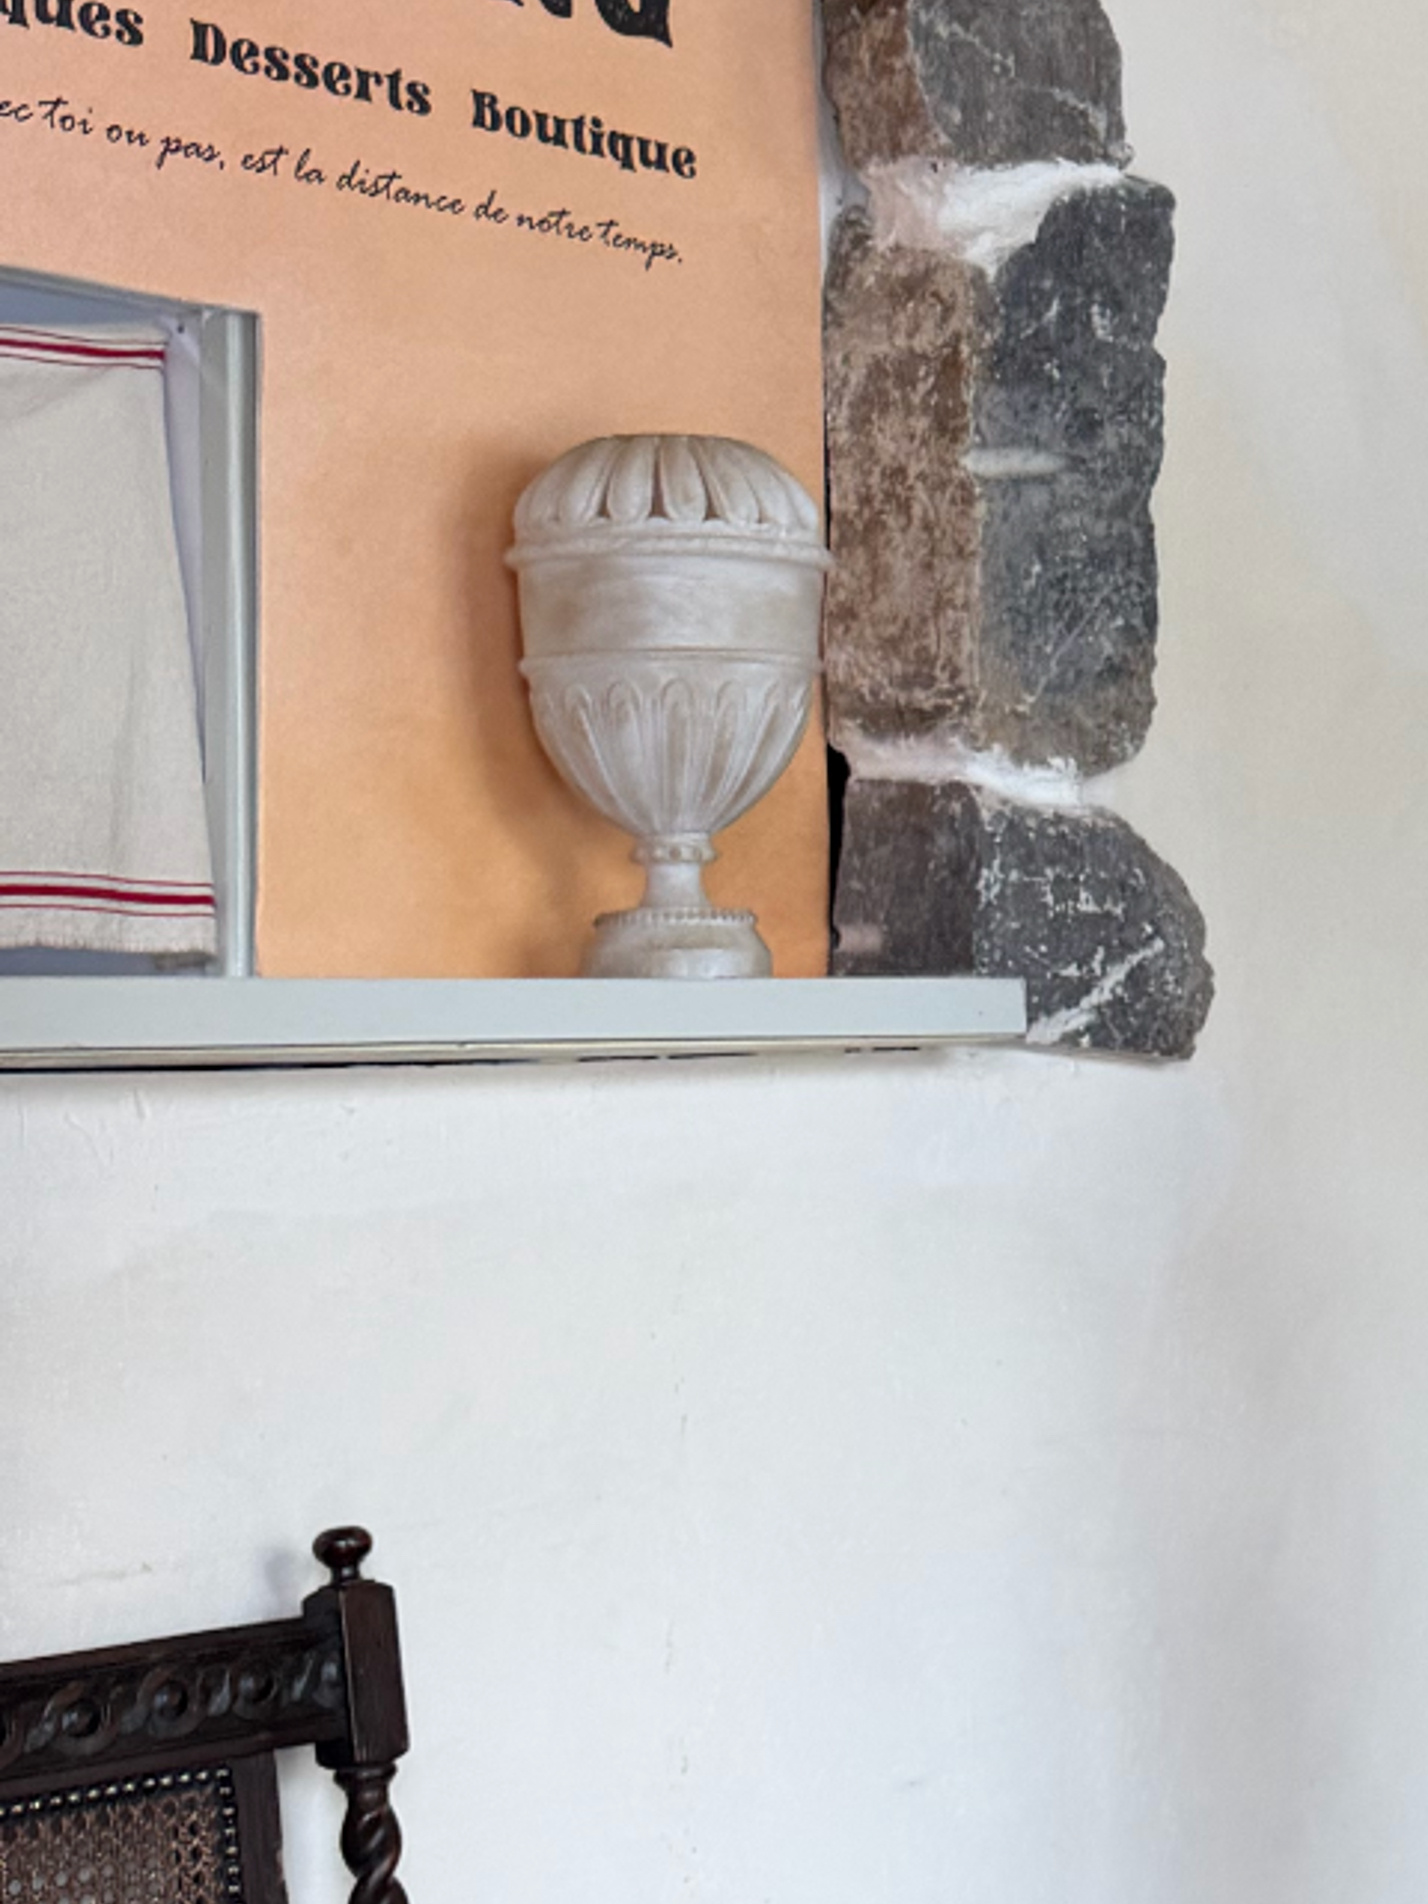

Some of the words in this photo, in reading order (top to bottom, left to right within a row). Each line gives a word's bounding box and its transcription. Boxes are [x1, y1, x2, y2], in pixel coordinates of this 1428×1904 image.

[189, 17, 431, 116] Desserts
[470, 88, 696, 179] Boutique
[38, 95, 93, 135] toi
[106, 124, 149, 147] ou
[156, 135, 224, 171] pas,
[240, 144, 289, 177] est
[293, 147, 326, 185] la
[336, 159, 465, 215] distance
[473, 189, 509, 224] de
[516, 207, 592, 242] notre
[596, 219, 683, 272] temps.
